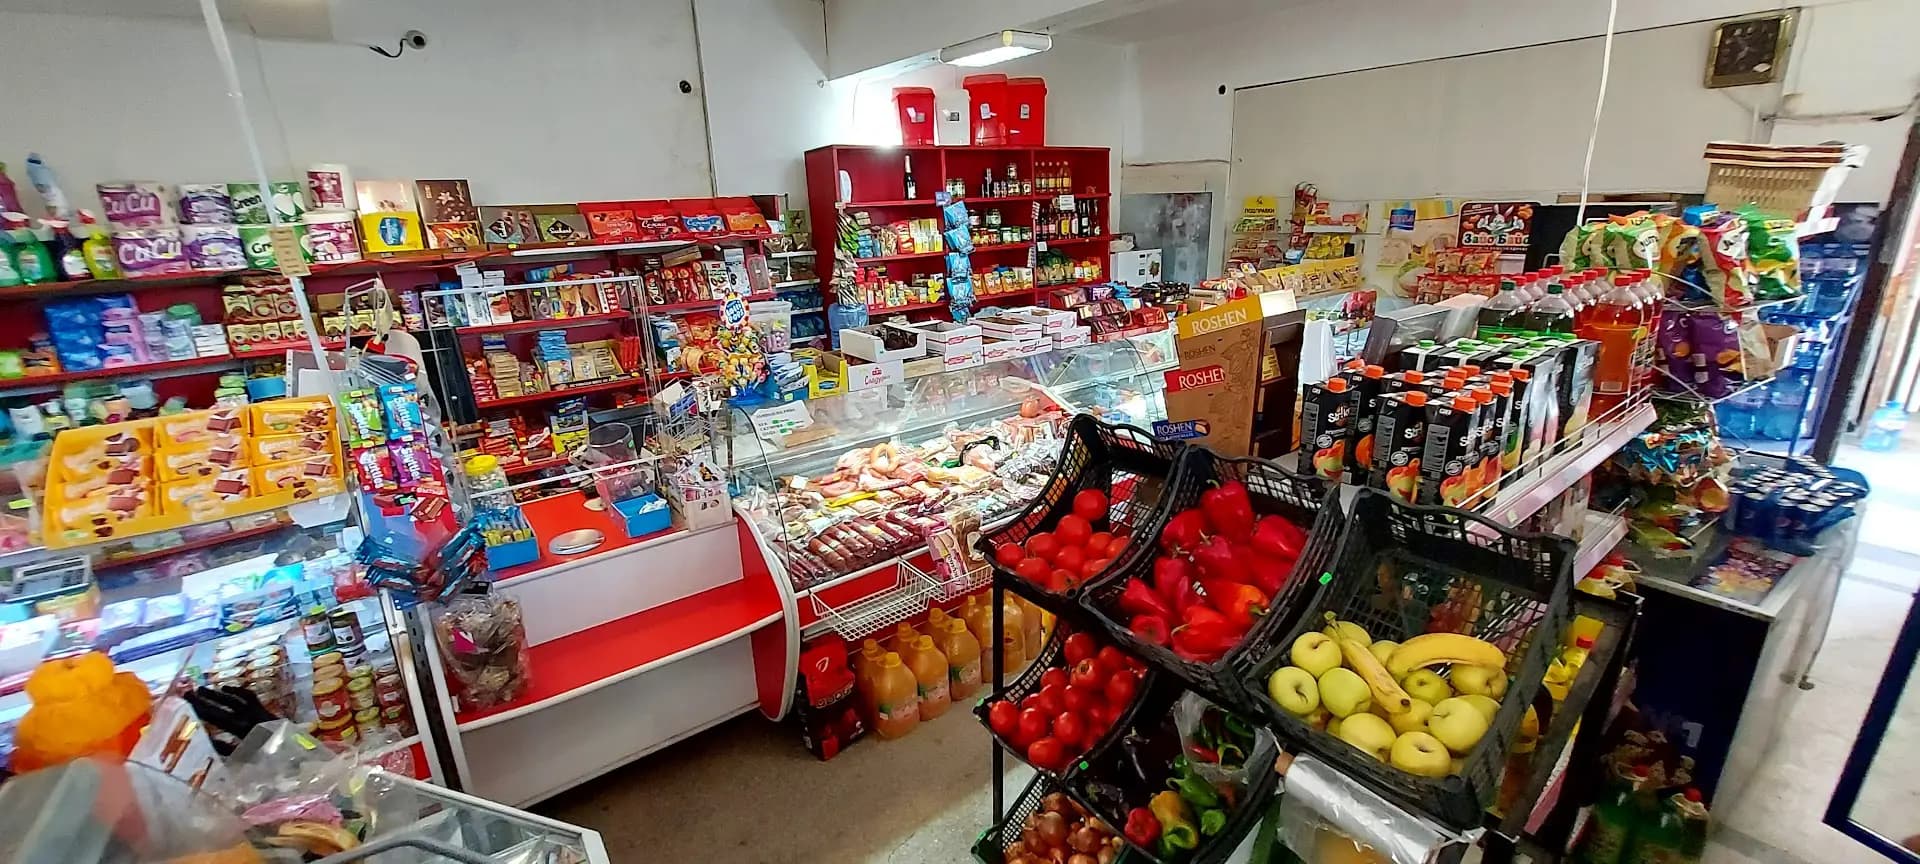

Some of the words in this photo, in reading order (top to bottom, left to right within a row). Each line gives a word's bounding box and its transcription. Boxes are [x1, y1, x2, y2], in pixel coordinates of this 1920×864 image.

[233, 195, 262, 210] Green
[1192, 308, 1247, 334] ROSHEN
[1157, 421, 1193, 436] ROSHEN
